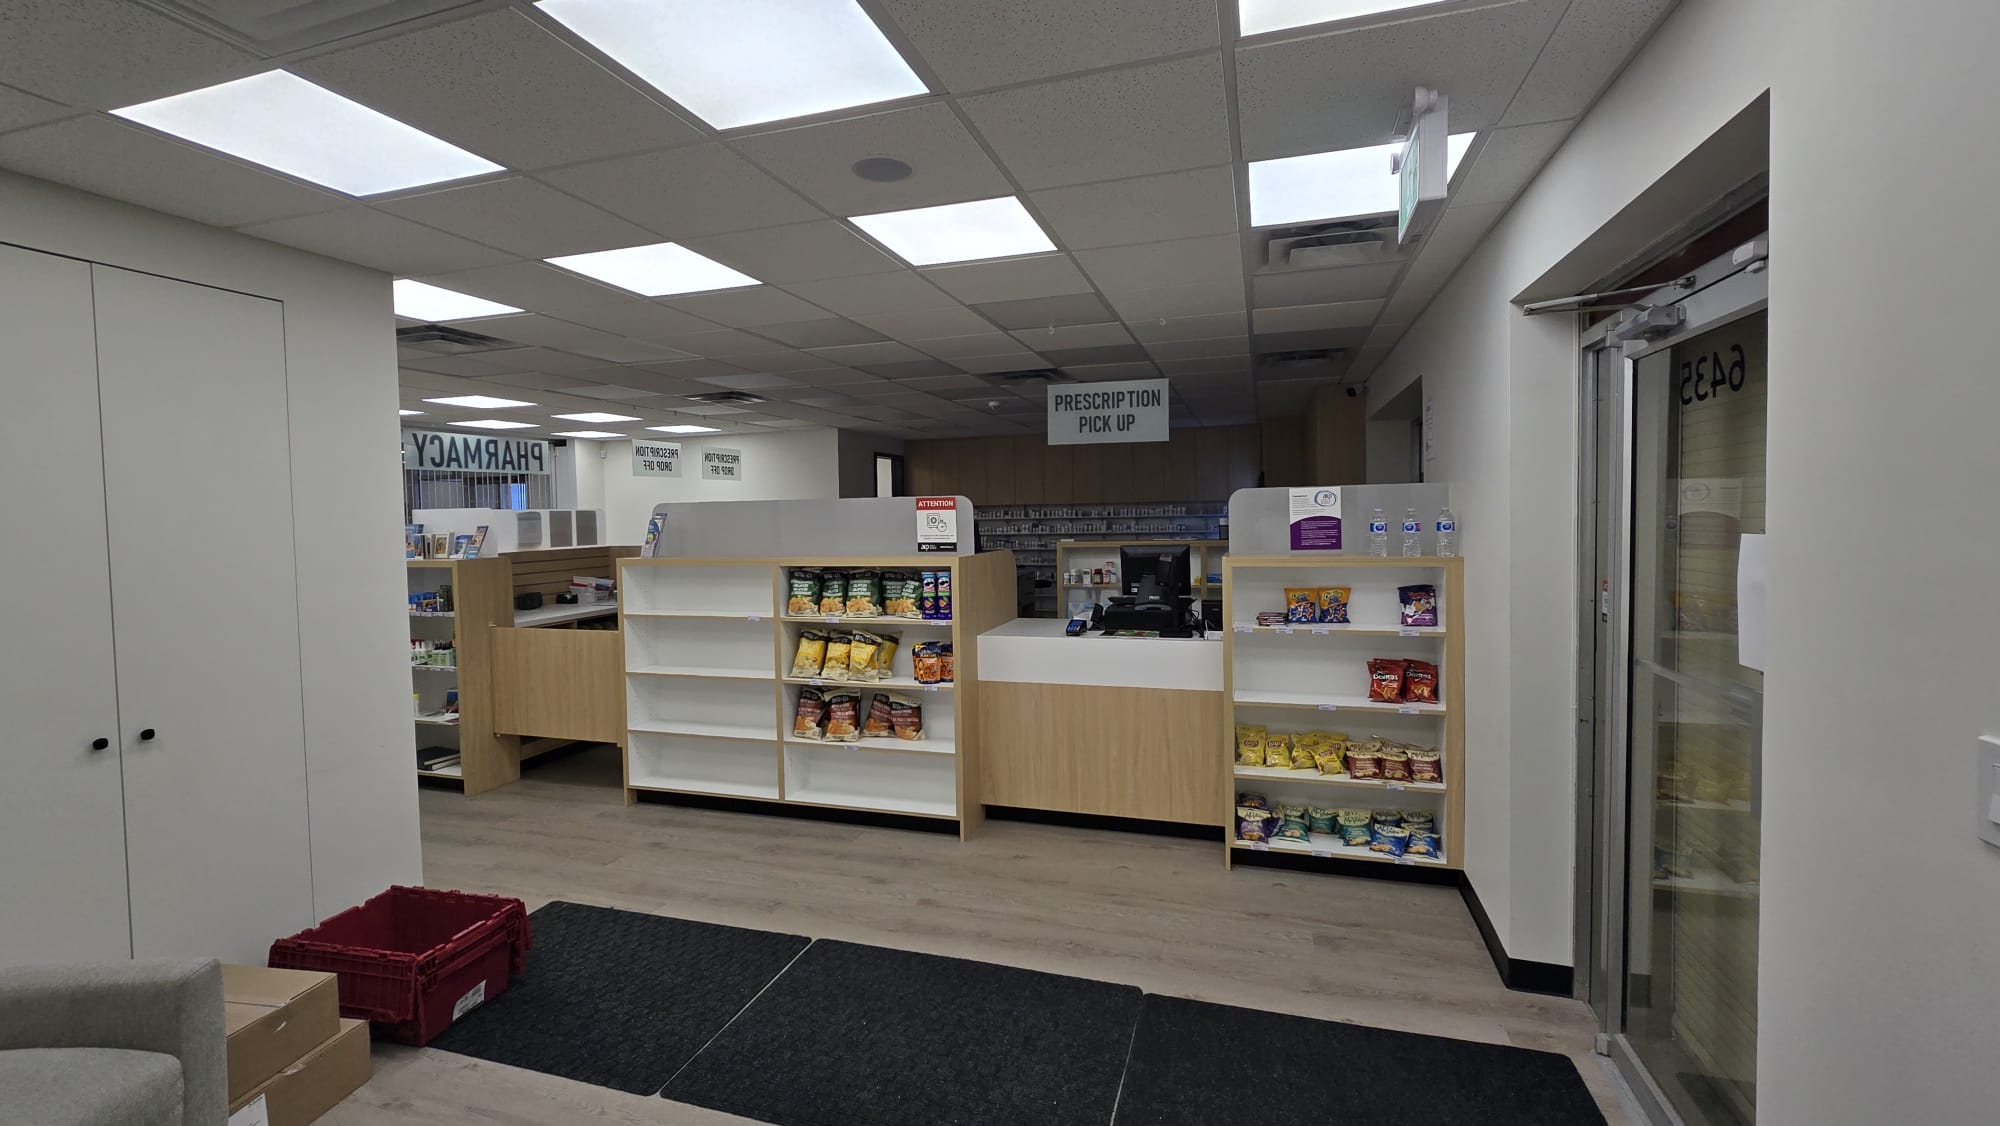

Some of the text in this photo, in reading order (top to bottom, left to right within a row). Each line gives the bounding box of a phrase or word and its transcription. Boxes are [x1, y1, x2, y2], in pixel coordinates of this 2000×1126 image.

[1055, 389, 1161, 412] PRESCRIPTION
[1079, 414, 1136, 433] PICK UP
[918, 500, 954, 508] ATTENTION
